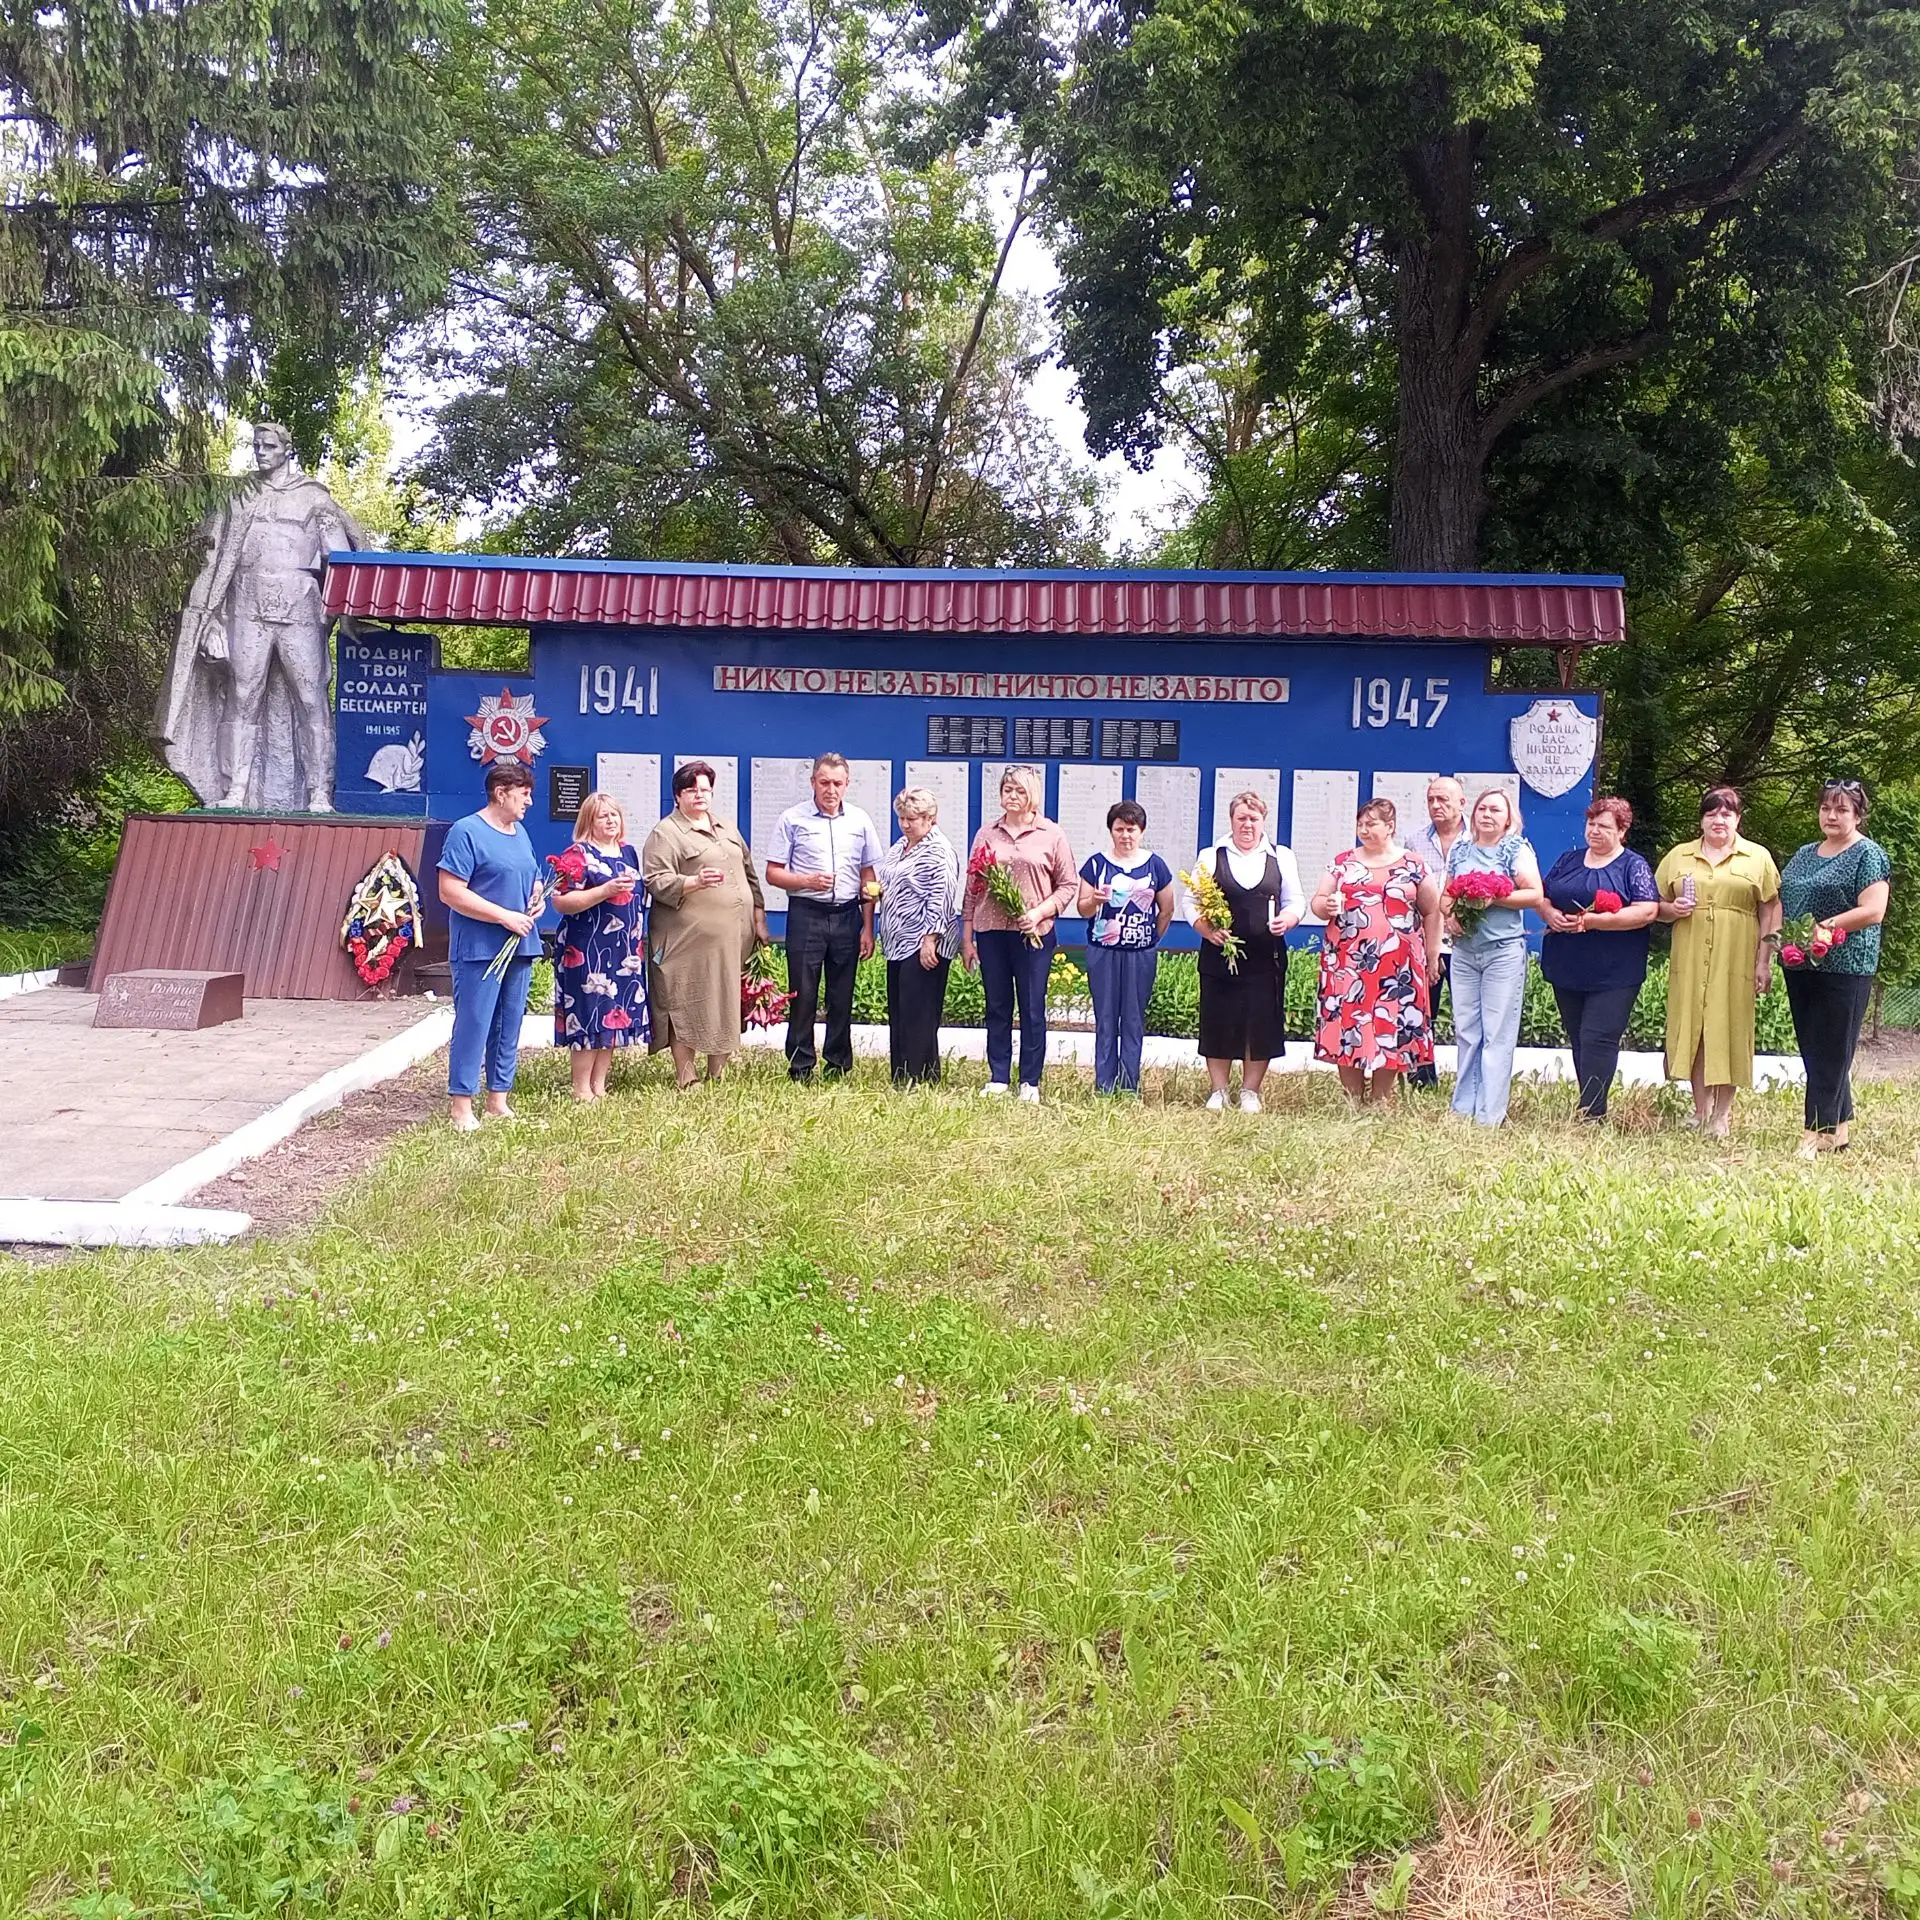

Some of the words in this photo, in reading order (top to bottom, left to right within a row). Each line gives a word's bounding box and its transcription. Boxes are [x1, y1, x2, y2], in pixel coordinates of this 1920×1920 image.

[345, 646, 423, 662] ПОДВИГ
[343, 680, 423, 696] СОЛДАТ
[579, 664, 659, 715] 1941
[720, 667, 827, 692] НИКТО
[834, 670, 877, 694] НЕ
[878, 671, 986, 697] ЗАБЫТ
[993, 674, 1098, 699] НИЧТО
[1106, 676, 1149, 700] НЕ
[1152, 677, 1283, 702] ЗАБЫТО
[340, 698, 427, 715] БЕССМЕРТЕН
[1352, 677, 1450, 729] 1945
[365, 725, 381, 735] 1941
[383, 725, 401, 736] 1945
[1529, 724, 1580, 735] РОДИНА
[1542, 735, 1566, 744] ВАС
[1526, 744, 1581, 755] НИКОГДА
[1544, 755, 1561, 765] НЕ
[151, 983, 198, 995] Родина
